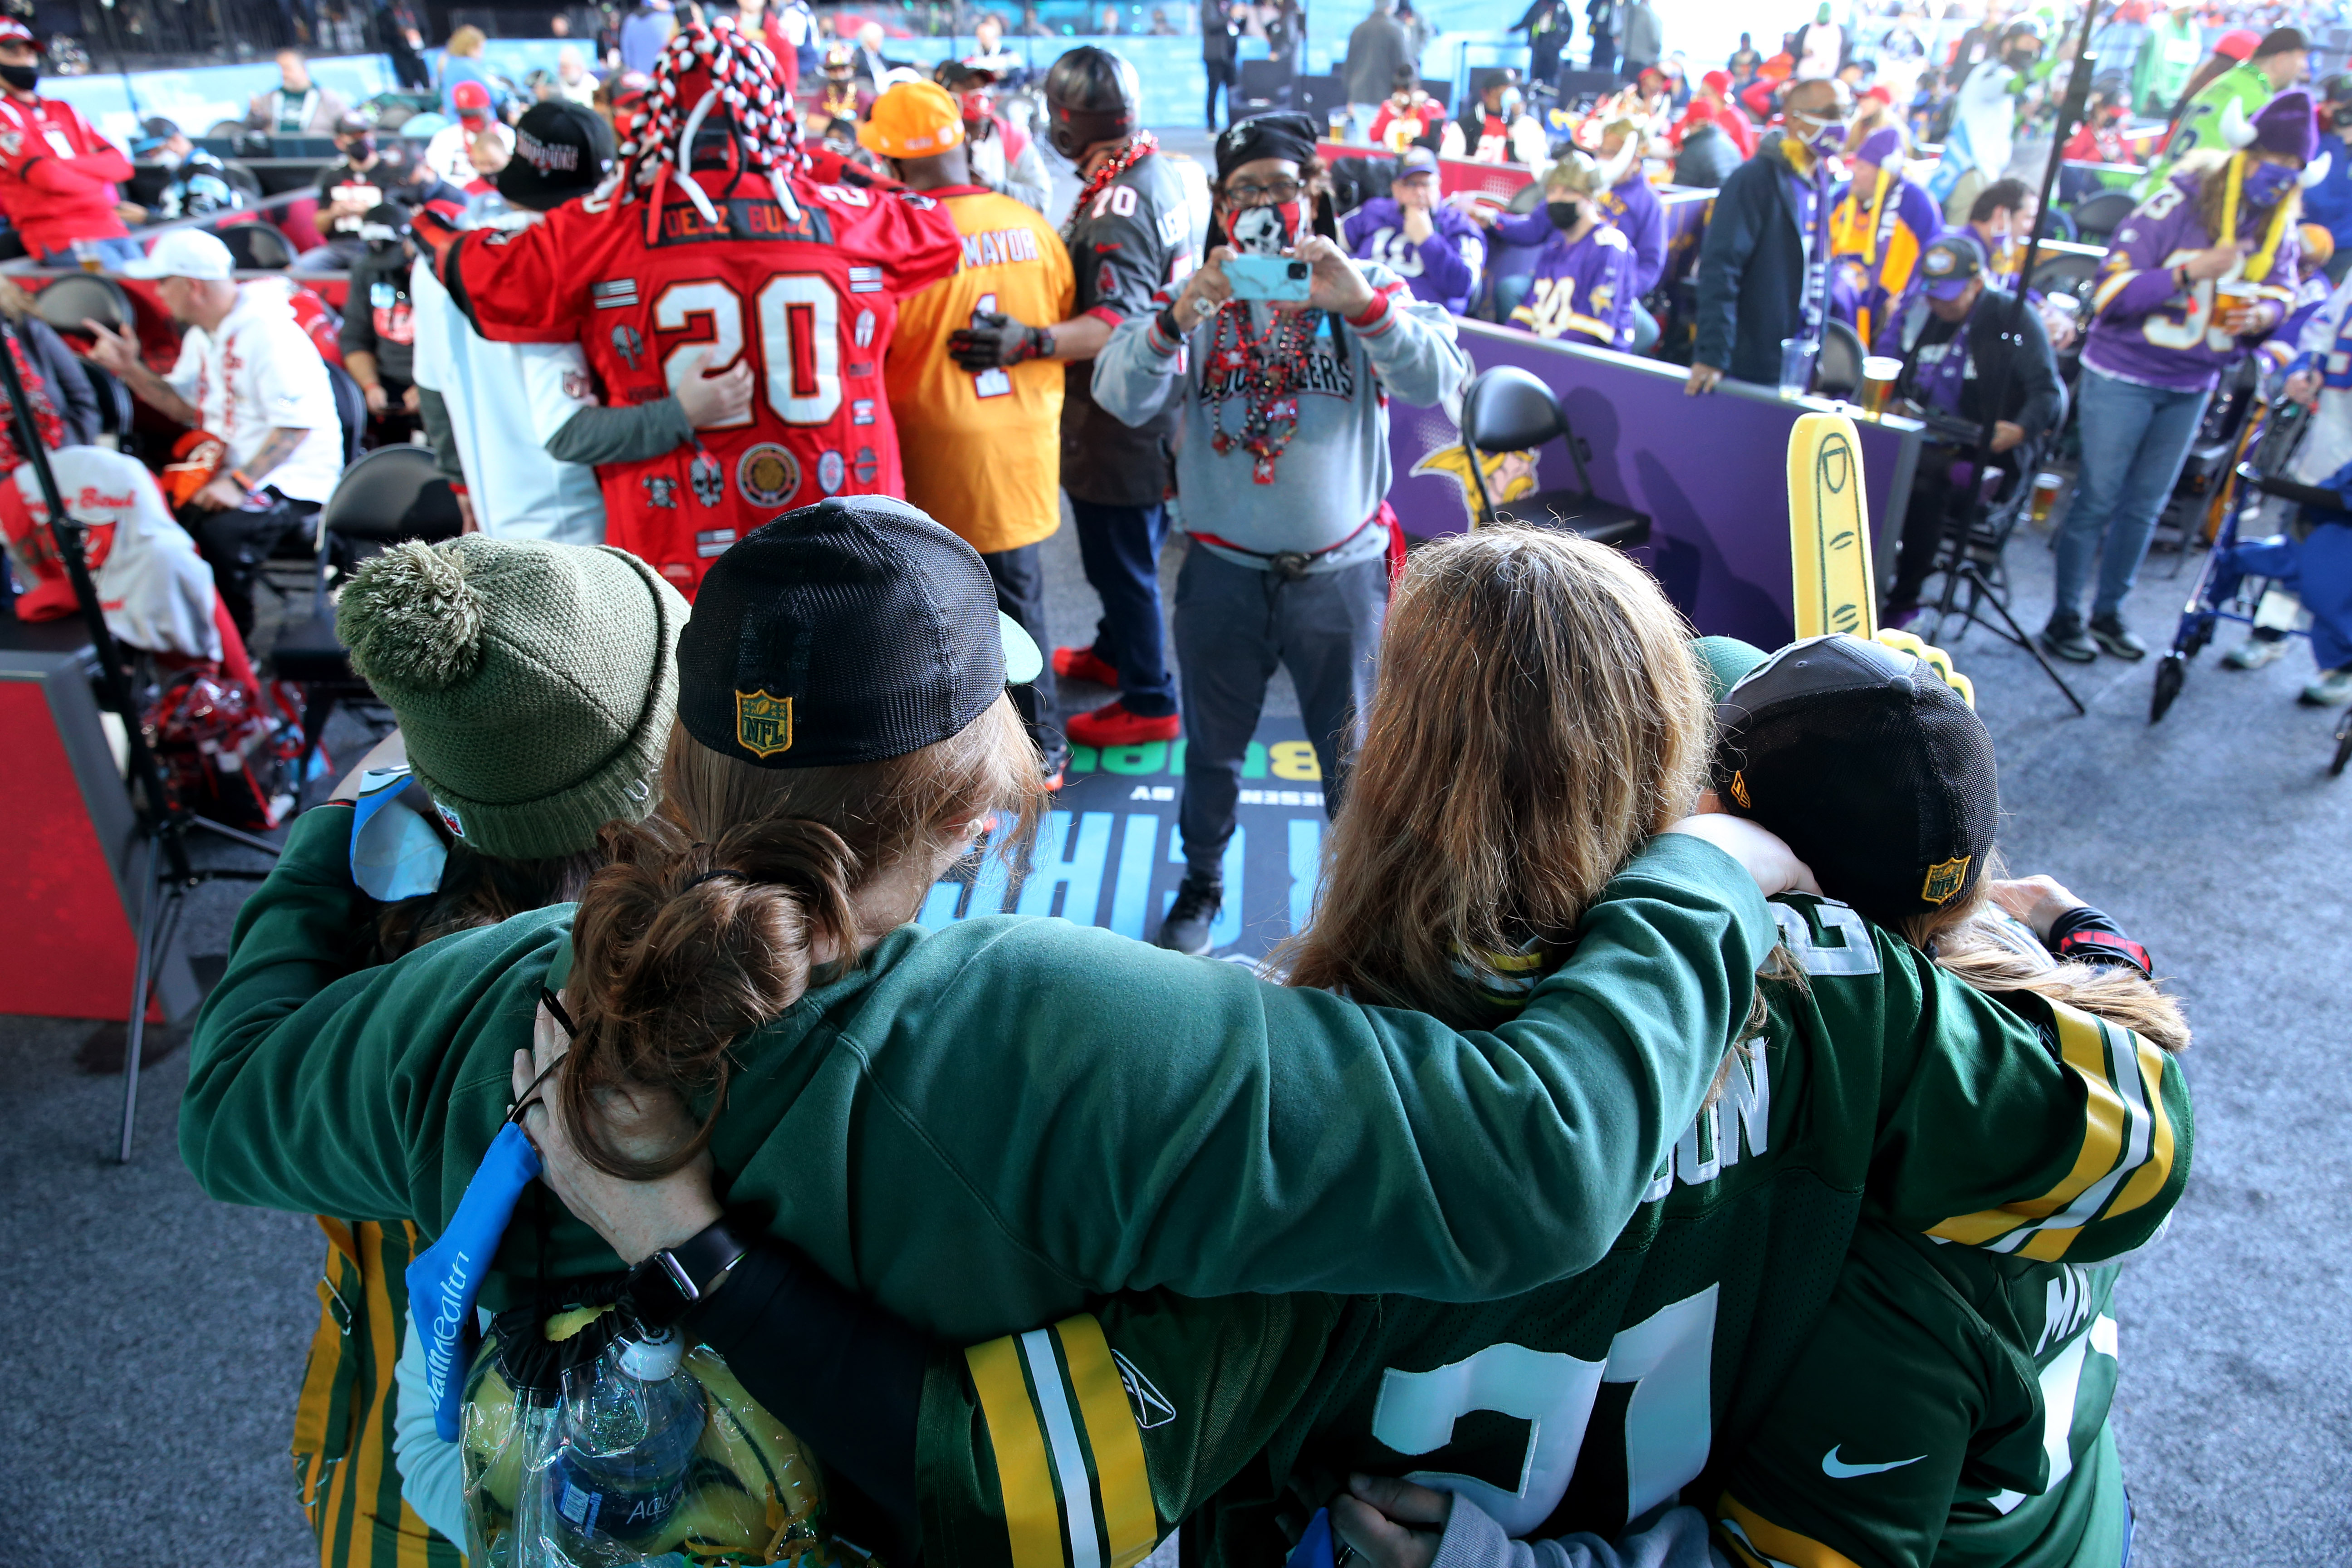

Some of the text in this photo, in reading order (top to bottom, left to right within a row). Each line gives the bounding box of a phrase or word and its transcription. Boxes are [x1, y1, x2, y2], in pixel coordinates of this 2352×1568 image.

[1091, 185, 1137, 218] 70
[960, 228, 1039, 268] MAYOR
[652, 271, 843, 434] 20
[744, 716, 784, 748] NFL
[1130, 785, 1175, 802] BY
[1926, 875, 1958, 897] NFL
